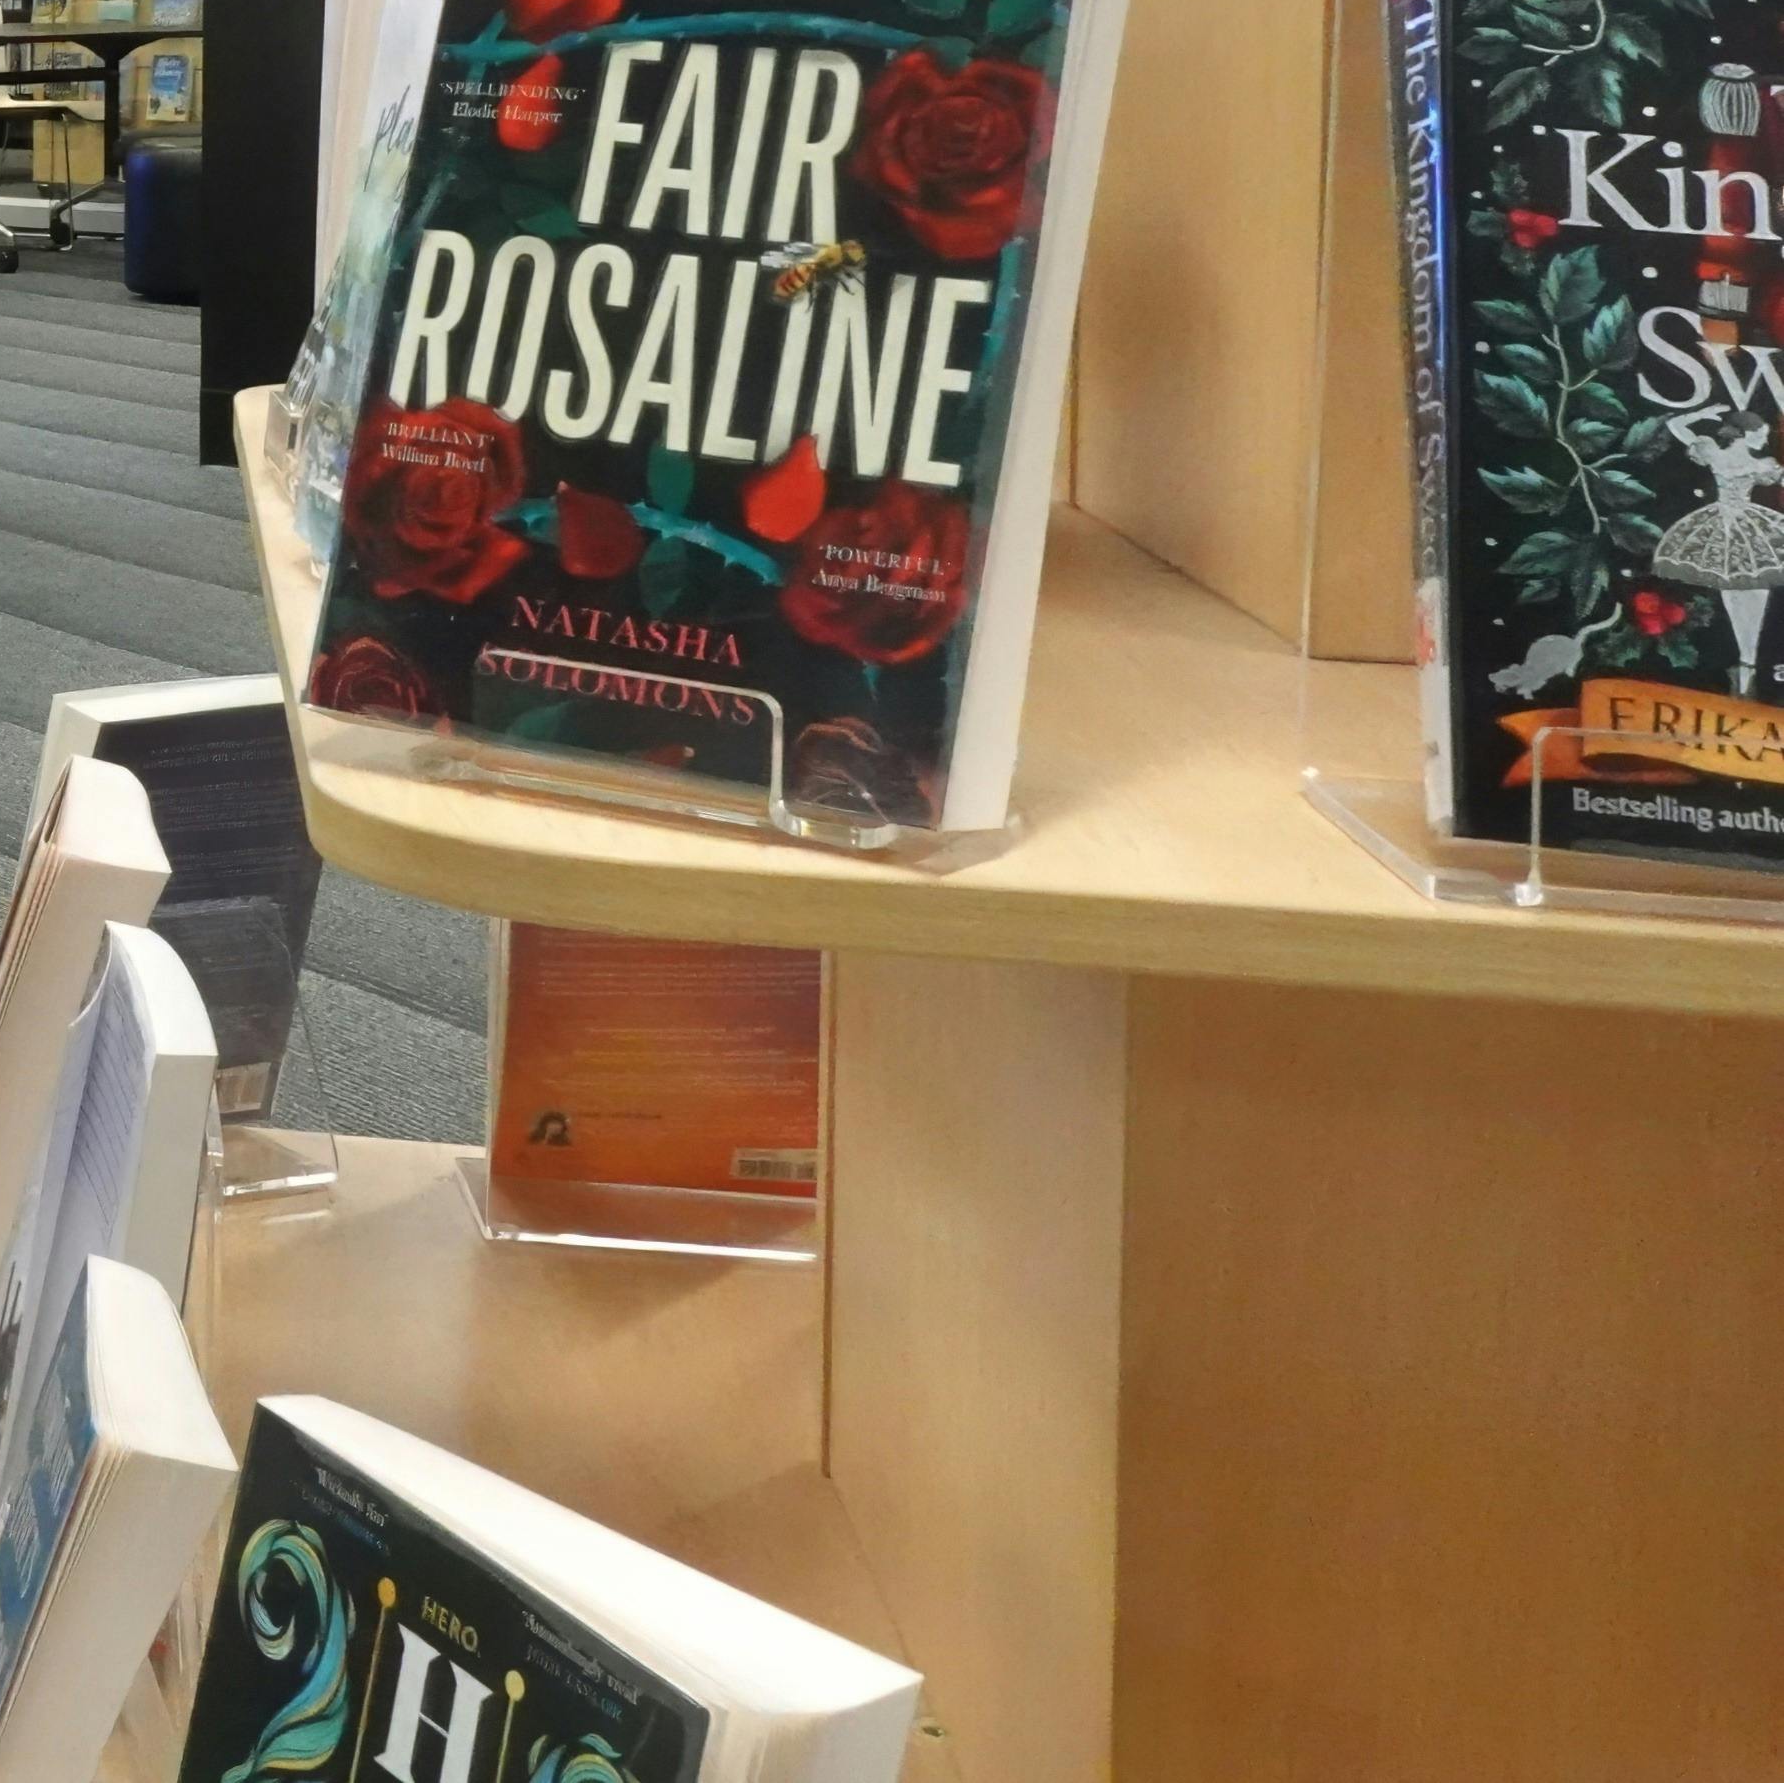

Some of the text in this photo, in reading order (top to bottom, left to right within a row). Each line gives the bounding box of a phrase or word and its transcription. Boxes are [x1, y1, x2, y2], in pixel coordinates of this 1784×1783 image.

[579, 40, 864, 246] FAIR
[1555, 128, 1784, 241] Kin
[388, 228, 993, 487] ROSALINE
[1414, 365, 1446, 418] of
[512, 595, 743, 667] NATASHA
[478, 642, 758, 727] SOLOMONS
[1573, 787, 1784, 834] Bestselling auth
